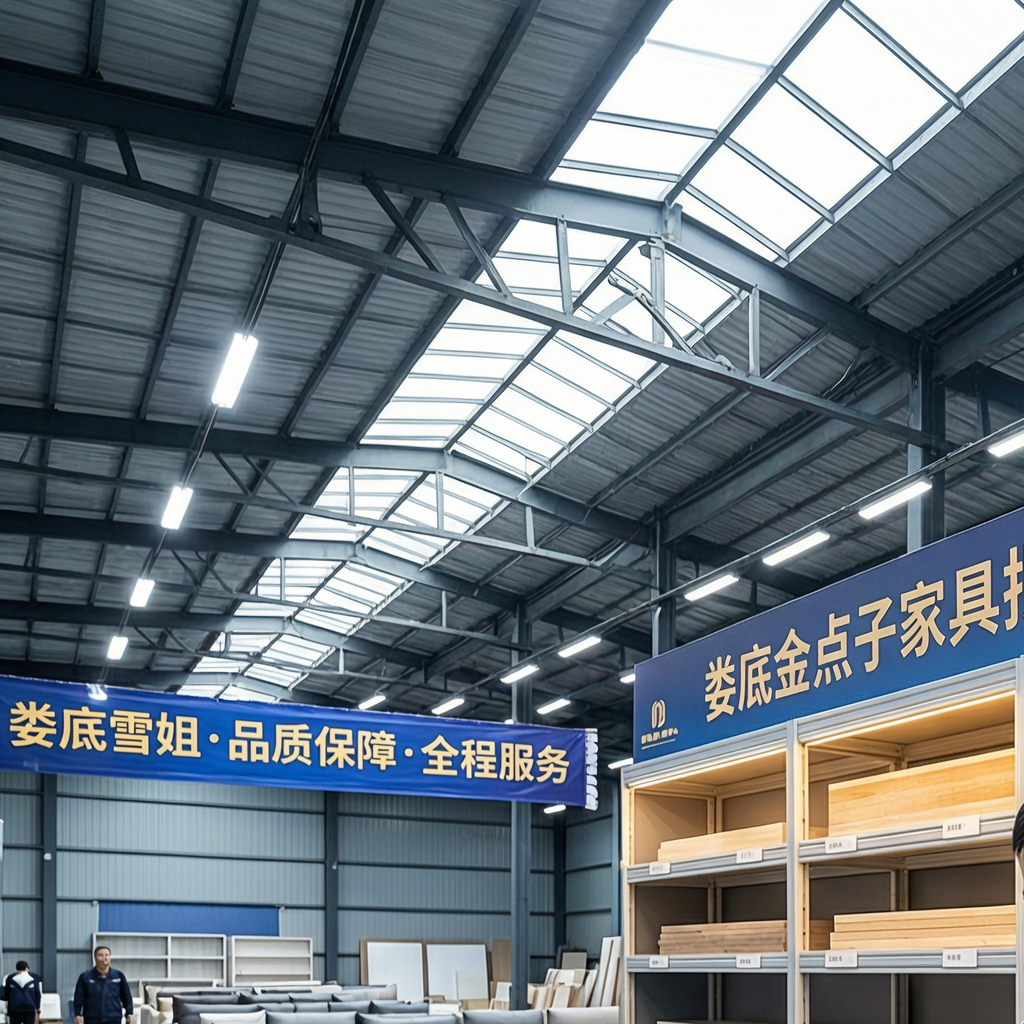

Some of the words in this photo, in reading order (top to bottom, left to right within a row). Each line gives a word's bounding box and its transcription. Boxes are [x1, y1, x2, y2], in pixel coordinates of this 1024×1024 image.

[9, 700, 571, 785] 娄底雪姐·品质保障·全程服务
